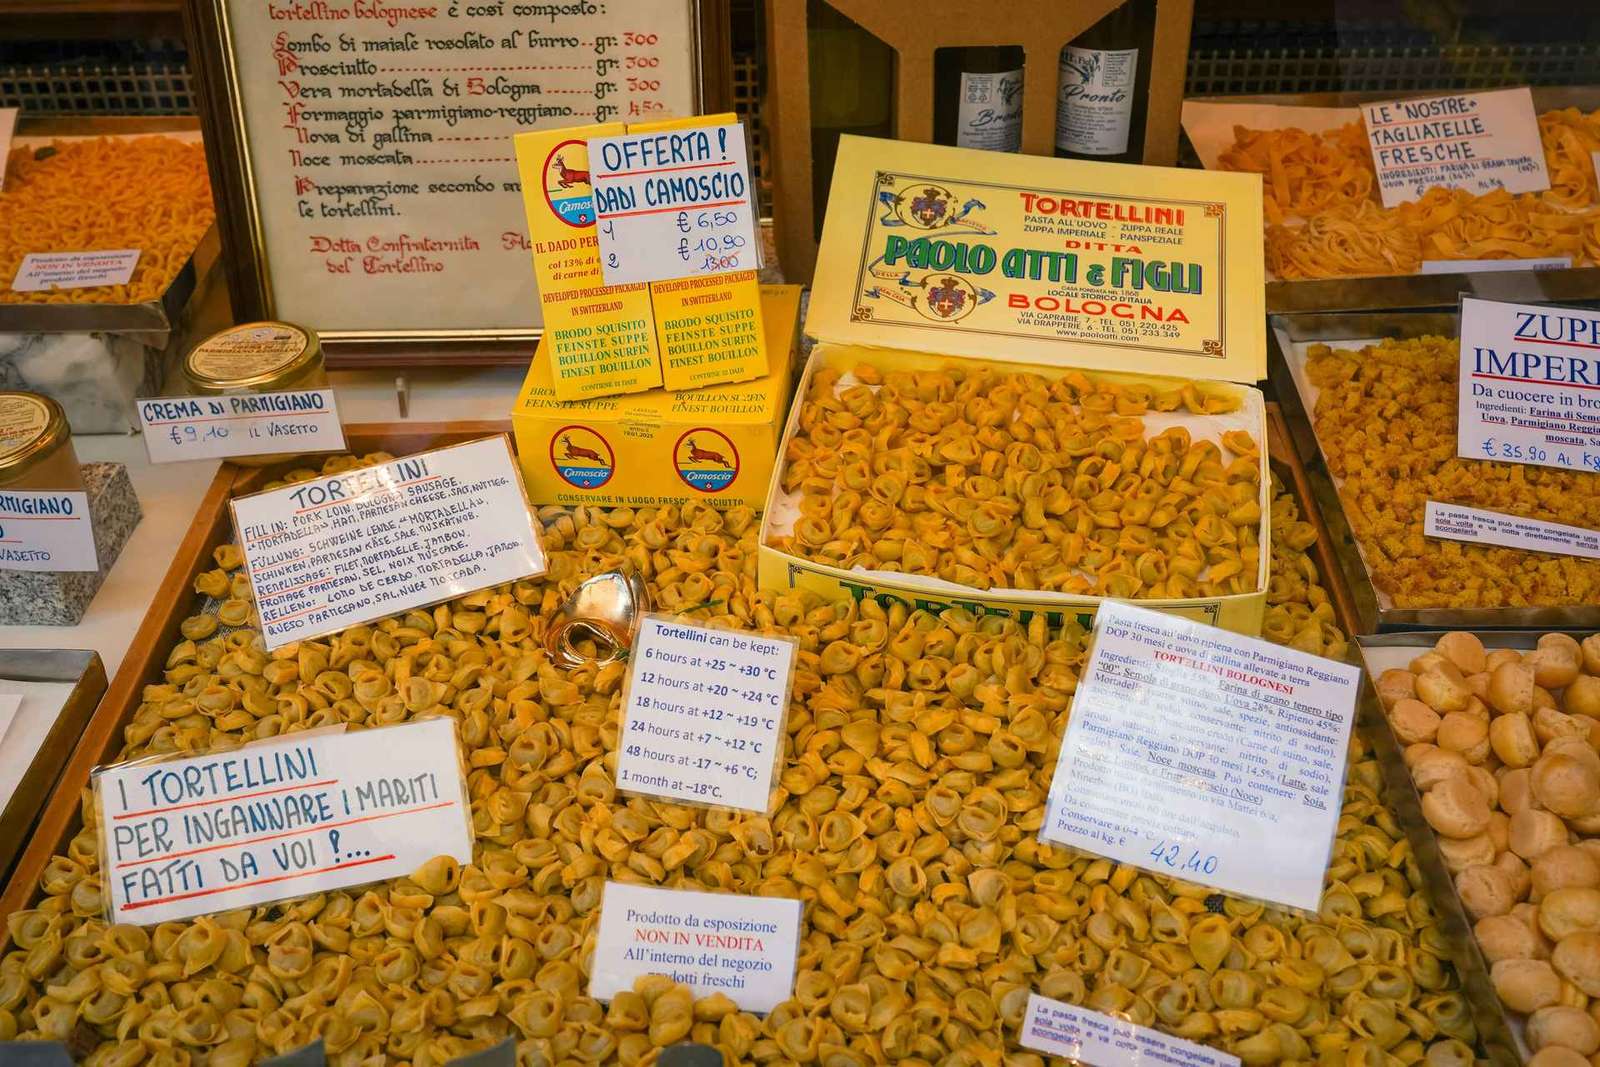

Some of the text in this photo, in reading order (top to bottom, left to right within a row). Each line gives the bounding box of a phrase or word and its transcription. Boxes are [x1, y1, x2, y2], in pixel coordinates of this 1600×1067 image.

[269, 0, 606, 27] tortellino bolognese composto:
[339, 30, 658, 51] di maiale rosolato al burro 300
[274, 50, 659, 76] Prosciutto 300
[278, 77, 660, 101] Vera mortadella di Bologna 300
[283, 102, 572, 128] Formaggio parmigiano-reggiano
[1370, 107, 1392, 124] LE
[374, 125, 432, 150] gallina
[1371, 118, 1485, 146] TAGLIATELLE
[289, 150, 413, 166] Noce moscata
[602, 131, 710, 171] OFFERTA
[1381, 141, 1475, 166] FRESCHE
[429, 175, 495, 193] secondo
[595, 172, 745, 213] DADI CAMOSCIO
[321, 198, 401, 217] tortellini.
[1020, 192, 1185, 226] TORTELLINI
[697, 211, 737, 229] 6,50
[1024, 215, 1184, 235] PASTA ALL'UOVO ZUPPA REALE
[310, 236, 361, 253] Dotta
[535, 236, 599, 254] IL DADO PER
[1024, 225, 1184, 245] ZUPPA IMPERIALE PANSPEZIALE
[608, 234, 745, 268] 2 10,90
[1065, 240, 1143, 254] DITTA
[884, 235, 1202, 295] PAOLO ATTI FIGLI
[690, 292, 732, 305] SWITZERLAND
[1048, 290, 1152, 305] LOCALE STORICO D'ITALIA
[578, 302, 623, 315] SWITZERLAND
[1008, 293, 1190, 324] BOLOGNA
[665, 309, 754, 330] BRODO SQUISITO
[1020, 311, 1178, 331] VIA 220.425
[555, 320, 646, 341] BRODO SQUISITO
[666, 322, 756, 343] FEINSTE SUPPE
[1056, 328, 1139, 342] www.paoloatti.com
[1142, 329, 1180, 338] 233.349
[557, 333, 648, 353] FEINSTE SUPPE
[668, 335, 757, 355] BOUILLON SURFIN
[559, 344, 649, 366] BOUILLON SURFIN
[670, 347, 758, 368] FINEST BOUILLON
[561, 358, 652, 378] FINEST BOUILLON
[1472, 383, 1573, 406] Da cuocere in
[143, 392, 325, 422] CREMA DI PARMIGIANO
[525, 400, 766, 413] FEINSTE SUPPE BOUILLON
[1476, 400, 1574, 420] Ingredienti: Farina di
[184, 422, 318, 443] 9,10 VASETTO
[1511, 416, 1566, 430] Parmigiano
[1482, 438, 1547, 462] € 35,90
[563, 468, 732, 481] Camoscio Camoscio
[557, 494, 656, 505] CONSERVARE LUOGO
[244, 511, 322, 540] FILL PORK
[251, 528, 364, 569] FÜLLUNG: SCHWEINE
[328, 581, 374, 603] LOMO DE
[268, 619, 304, 636] QUESO
[1105, 627, 1143, 642] DOP 30
[656, 625, 780, 656] Tortellini can be kept:
[645, 648, 777, 680] 6 hours at +25 +30 °C
[1153, 650, 1224, 676] TORTELLINI
[1225, 668, 1294, 695] BOLOGNESI
[641, 672, 762, 703] 12 hours +20 +24
[1218, 679, 1323, 717] Farina grano tenero
[636, 696, 685, 714] 18 hours
[631, 720, 680, 739] 24 hours
[627, 745, 675, 764] 48 hours
[142, 747, 319, 807] TORTELLINI
[632, 772, 668, 788] month
[113, 773, 439, 861] PER INGANNARE MARITI
[1150, 840, 1218, 874] 42,40
[121, 837, 317, 906] FATTI DA VOI
[626, 909, 778, 934] Prodotto da esposizione
[634, 928, 764, 951] NON IN VENDITA
[624, 947, 773, 972] All'interno del negozio
[702, 972, 745, 989] freschi
